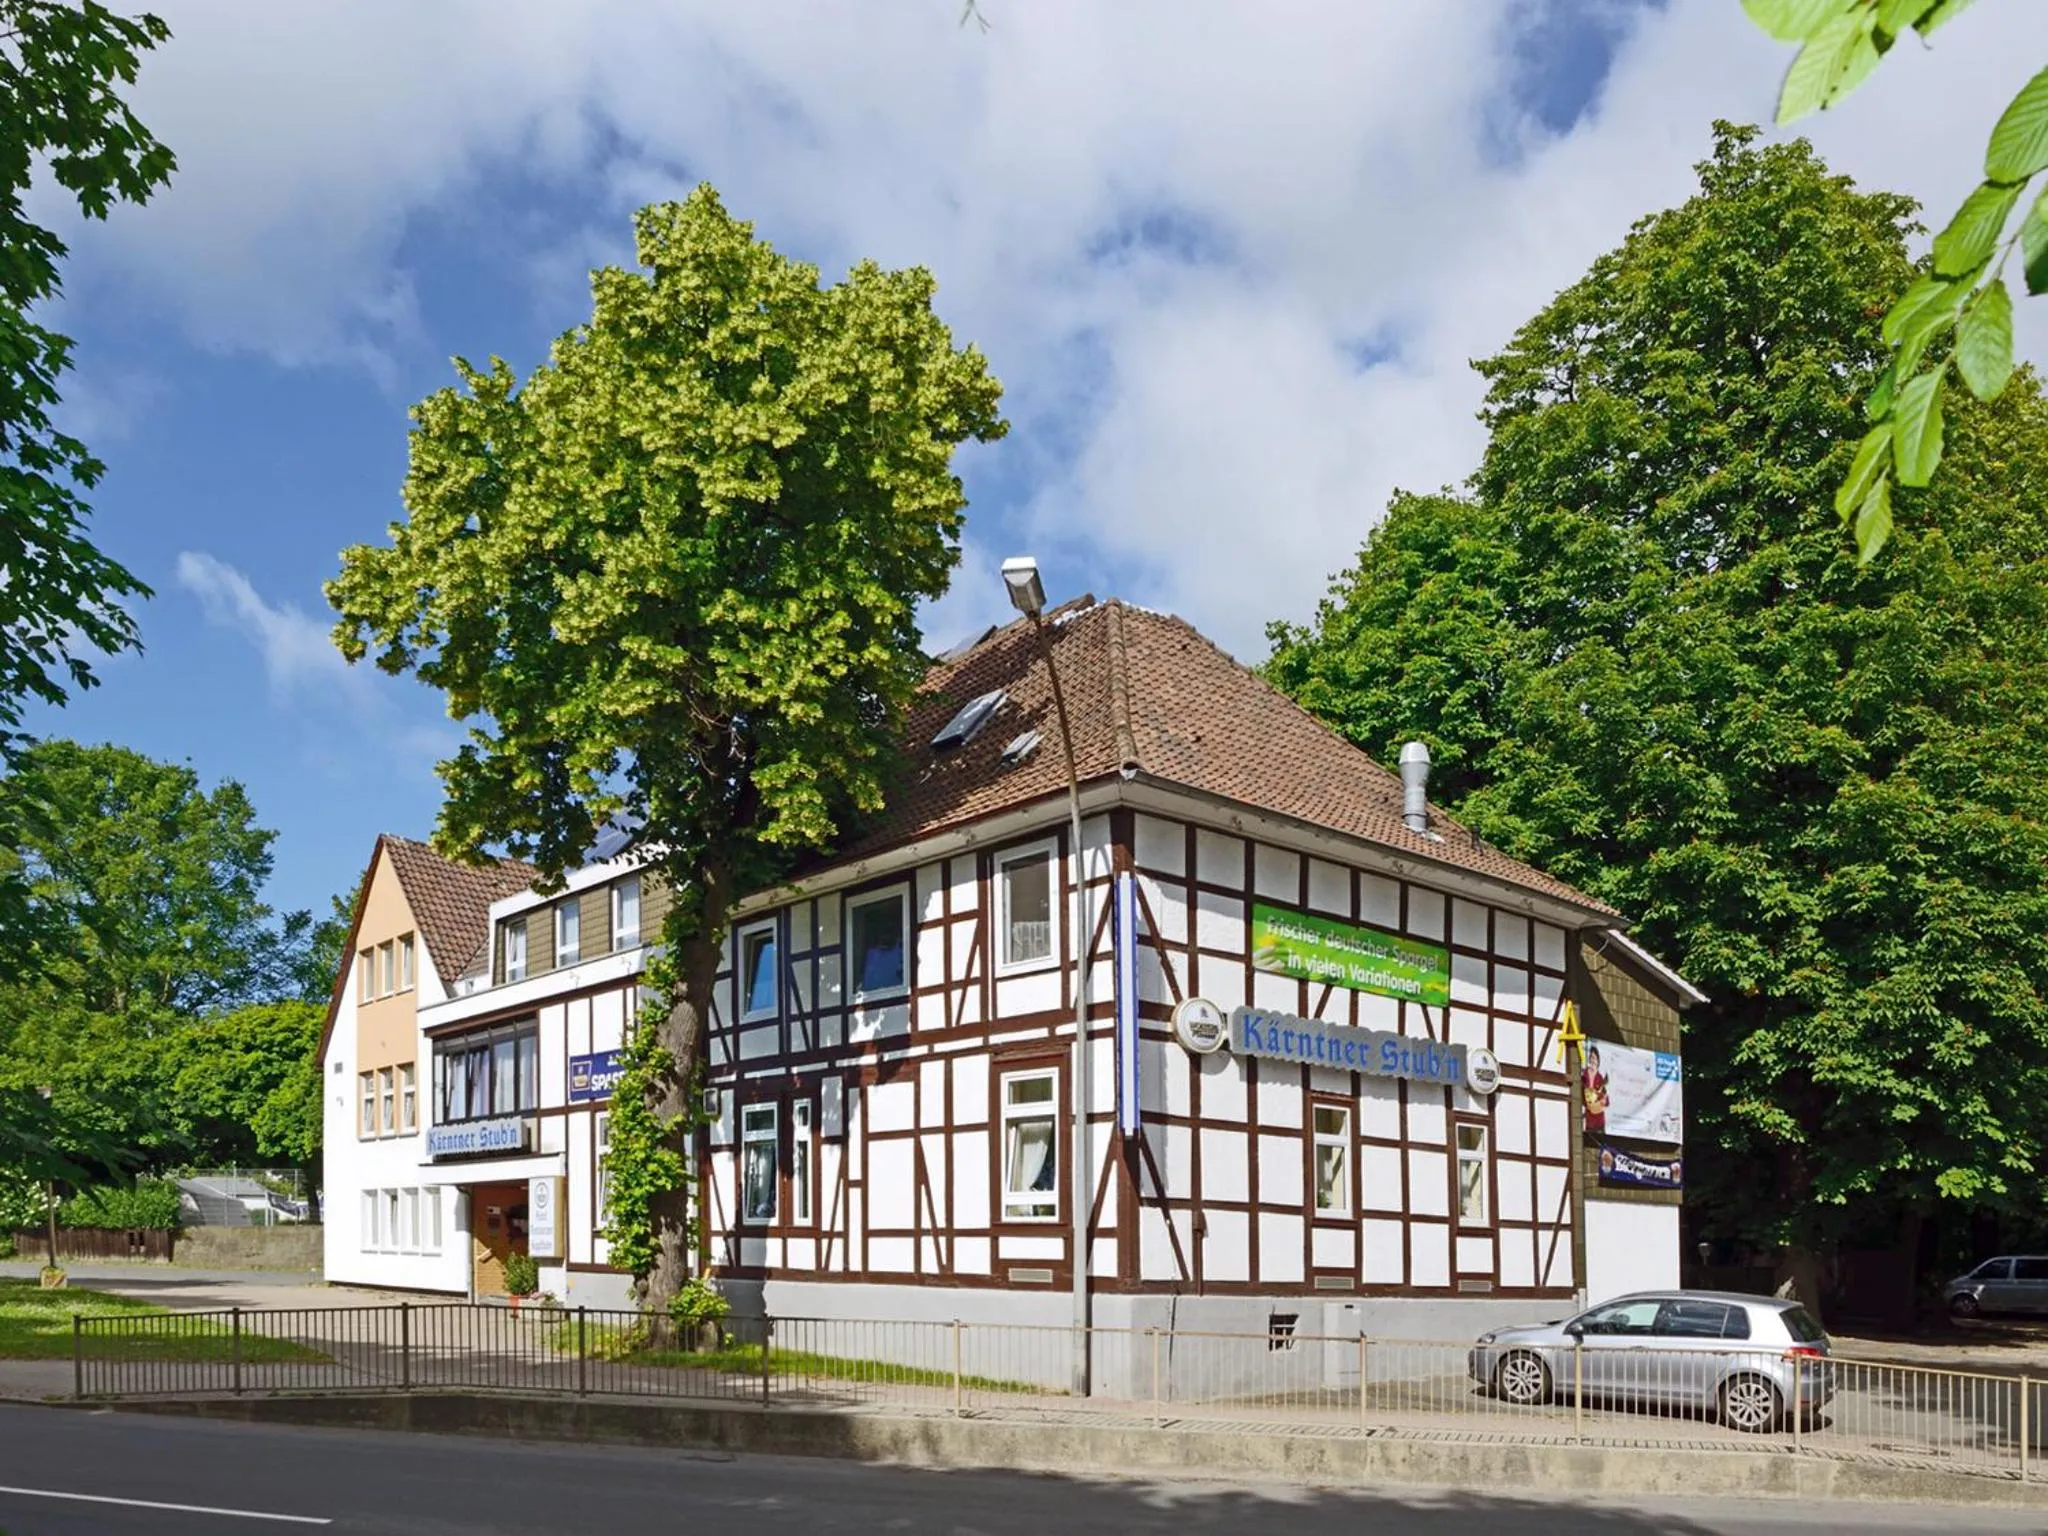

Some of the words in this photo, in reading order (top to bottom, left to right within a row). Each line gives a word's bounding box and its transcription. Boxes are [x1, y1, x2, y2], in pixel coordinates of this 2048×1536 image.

[1325, 929, 1390, 960] deutscher
[1392, 945, 1438, 973] Spargel
[1305, 954, 1346, 979] vielen
[1349, 962, 1421, 995] Variationen
[1243, 1014, 1371, 1067] Kärntner
[1380, 1039, 1459, 1081] Stub'n
